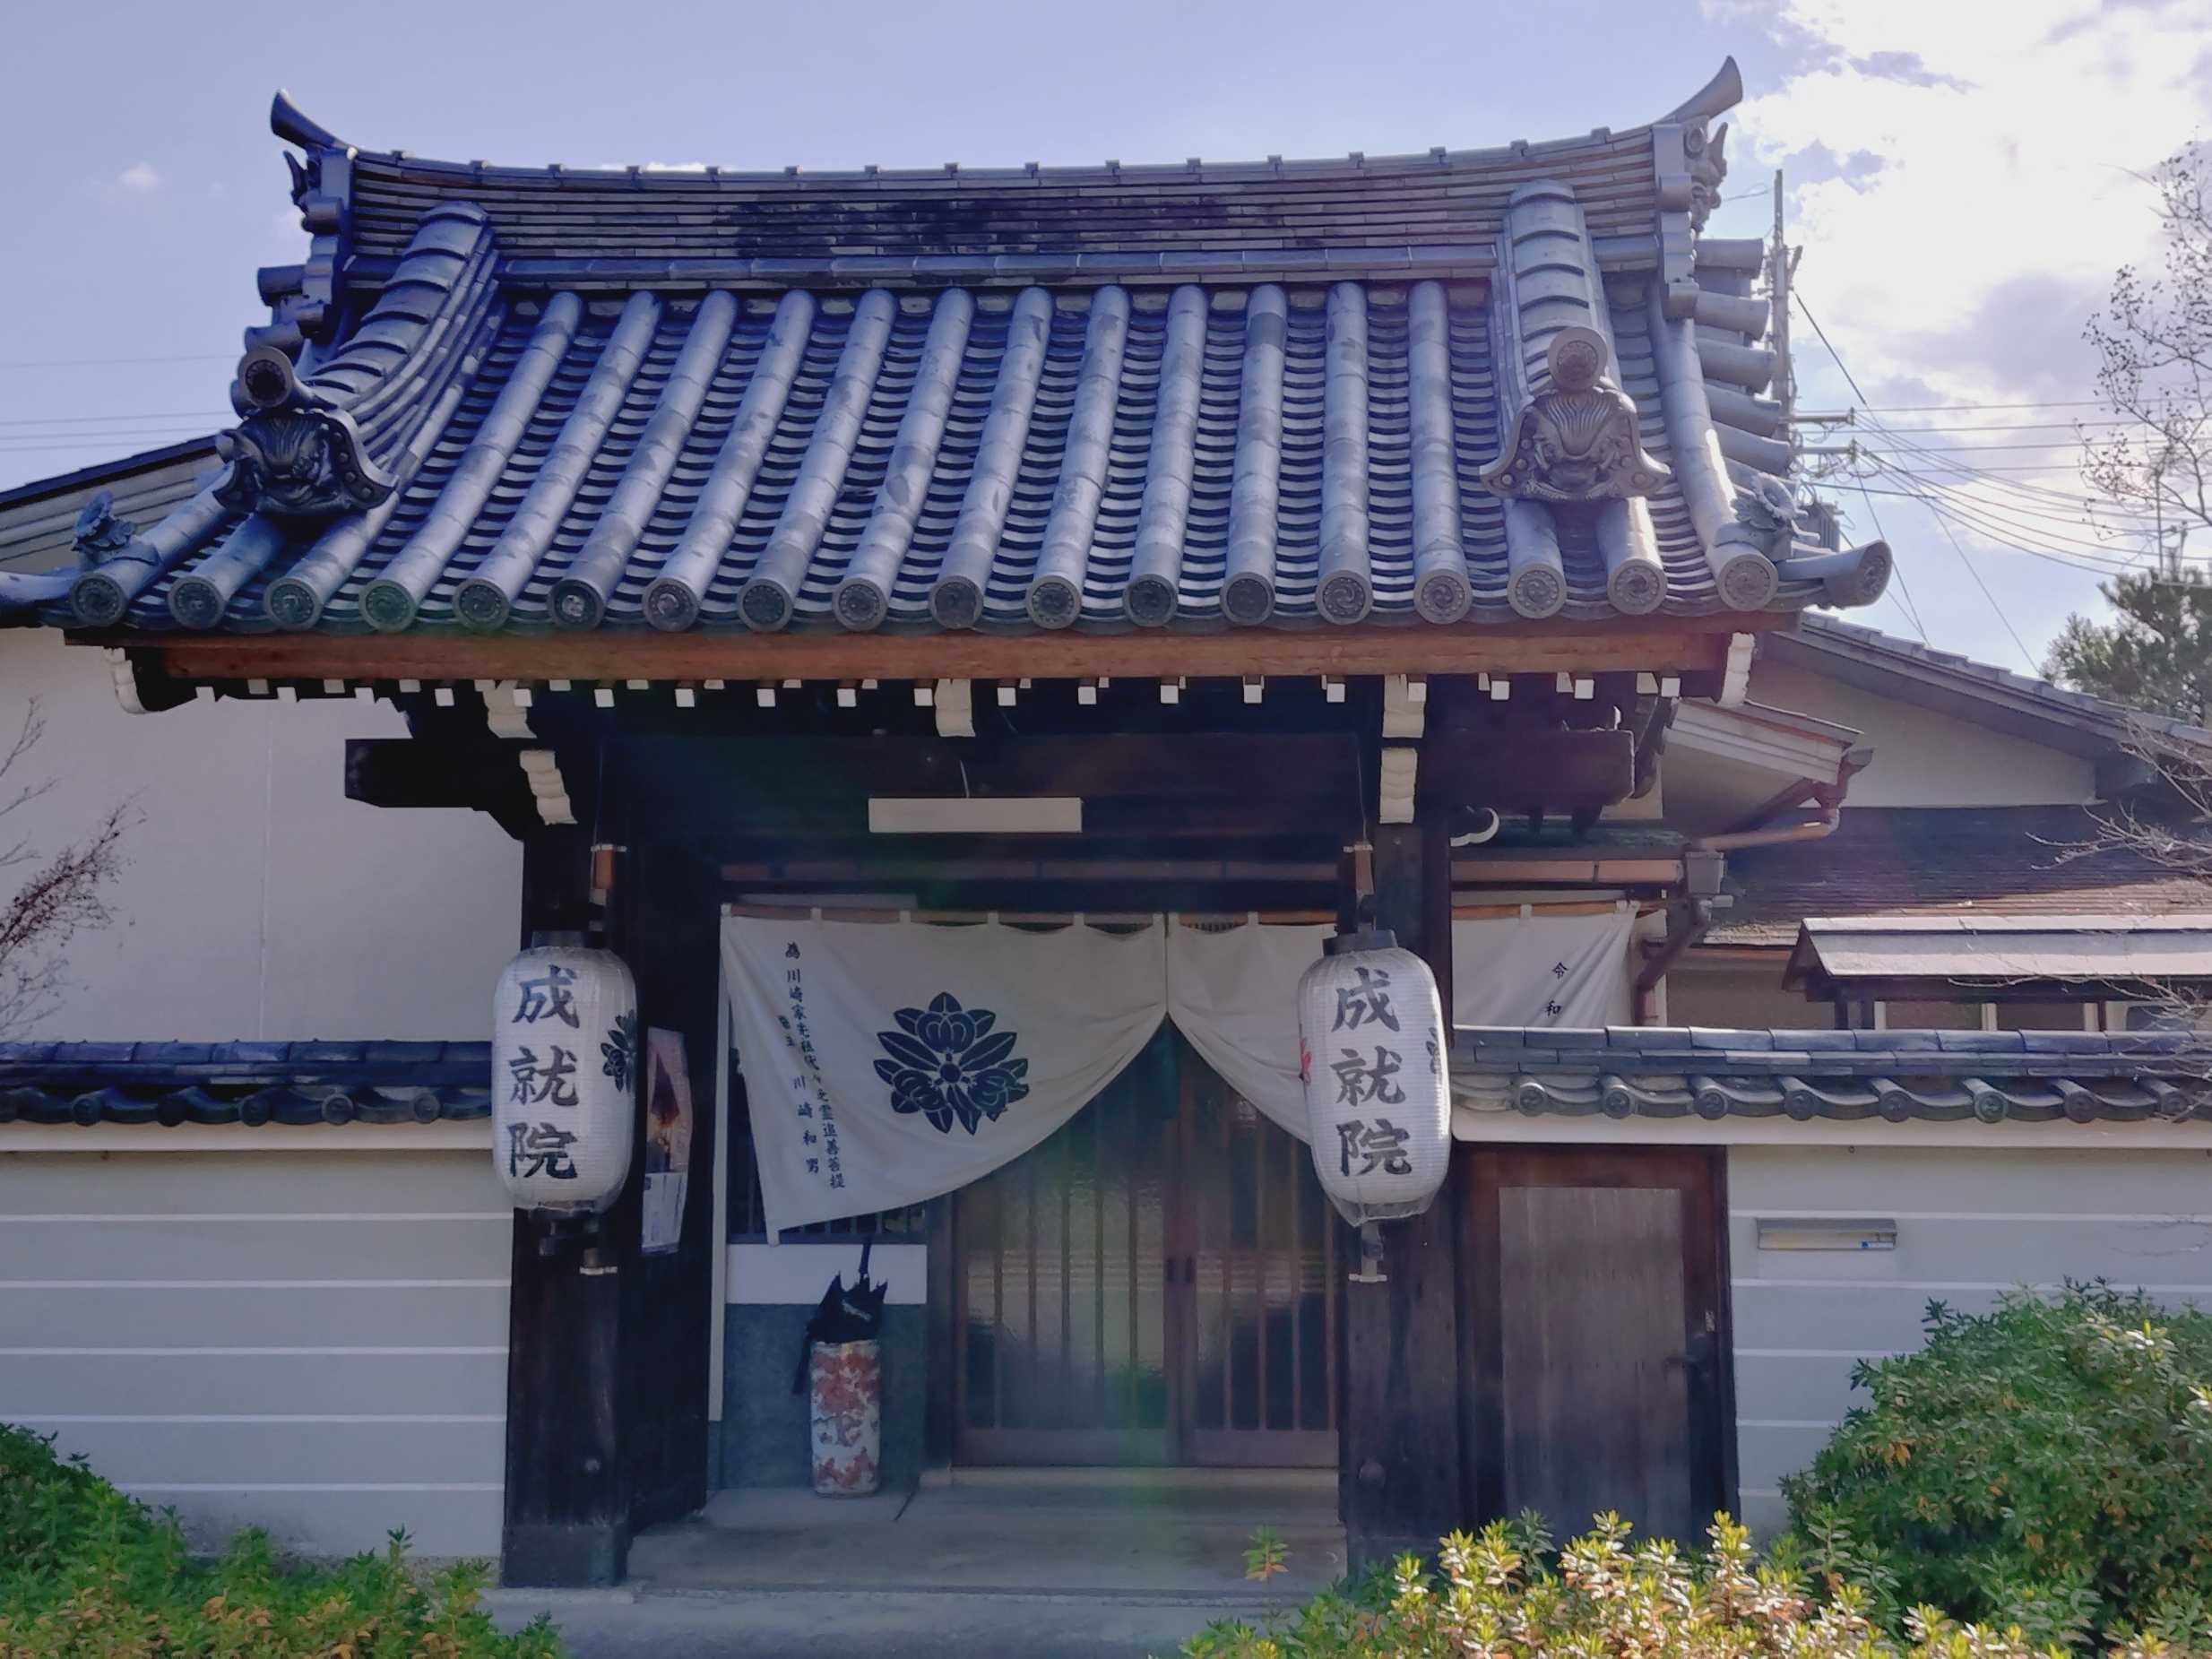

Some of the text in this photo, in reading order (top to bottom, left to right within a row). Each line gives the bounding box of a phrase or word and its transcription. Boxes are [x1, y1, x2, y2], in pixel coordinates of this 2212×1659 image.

[509, 963, 581, 1180] 成就院
[1330, 966, 1413, 1178] 成就院
[1545, 962, 1569, 1017] 令和
